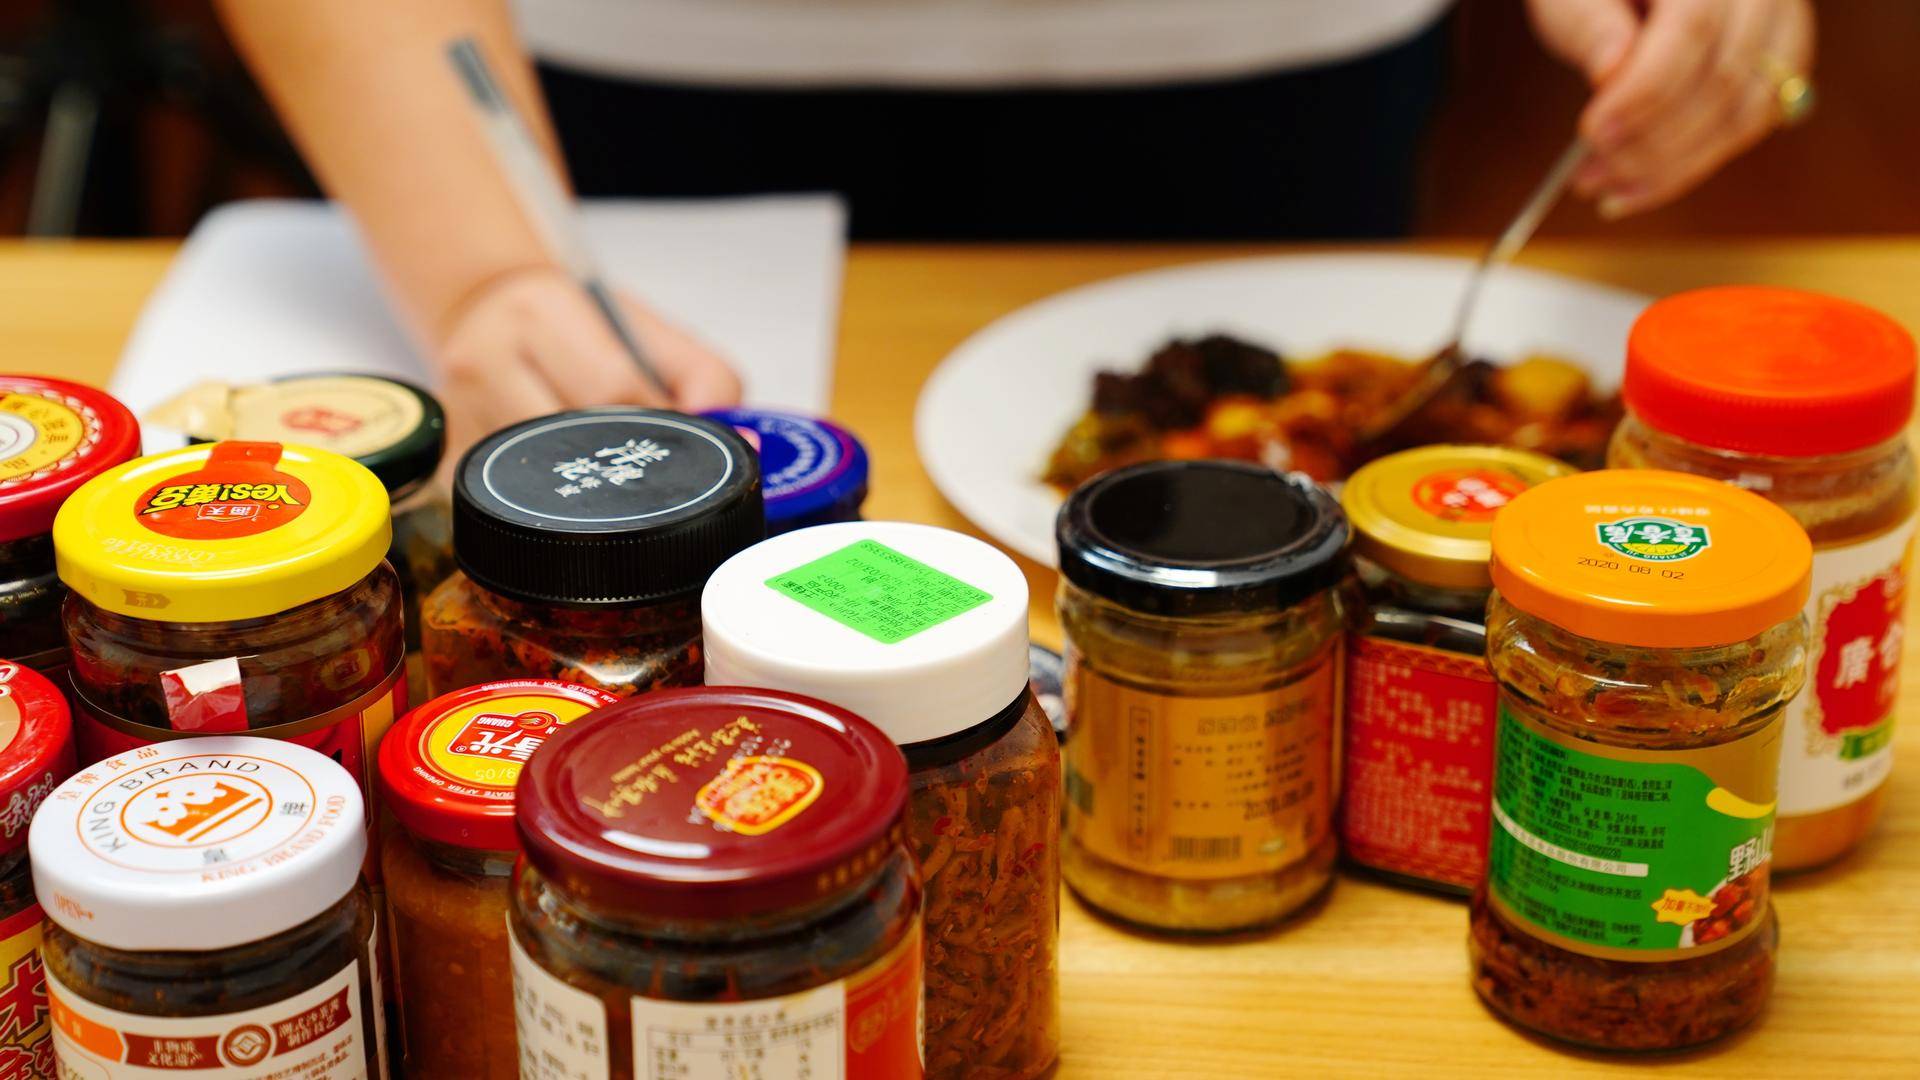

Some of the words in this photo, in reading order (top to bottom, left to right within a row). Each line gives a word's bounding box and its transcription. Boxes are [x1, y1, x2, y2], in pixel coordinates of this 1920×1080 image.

[1578, 557, 1619, 570] 2020
[1629, 564, 1651, 575] 08
[1661, 569, 1685, 580] 02
[476, 716, 515, 729] GUANG
[447, 783, 480, 796] AFTER
[88, 800, 128, 854] KING
[119, 760, 262, 791] BRAND
